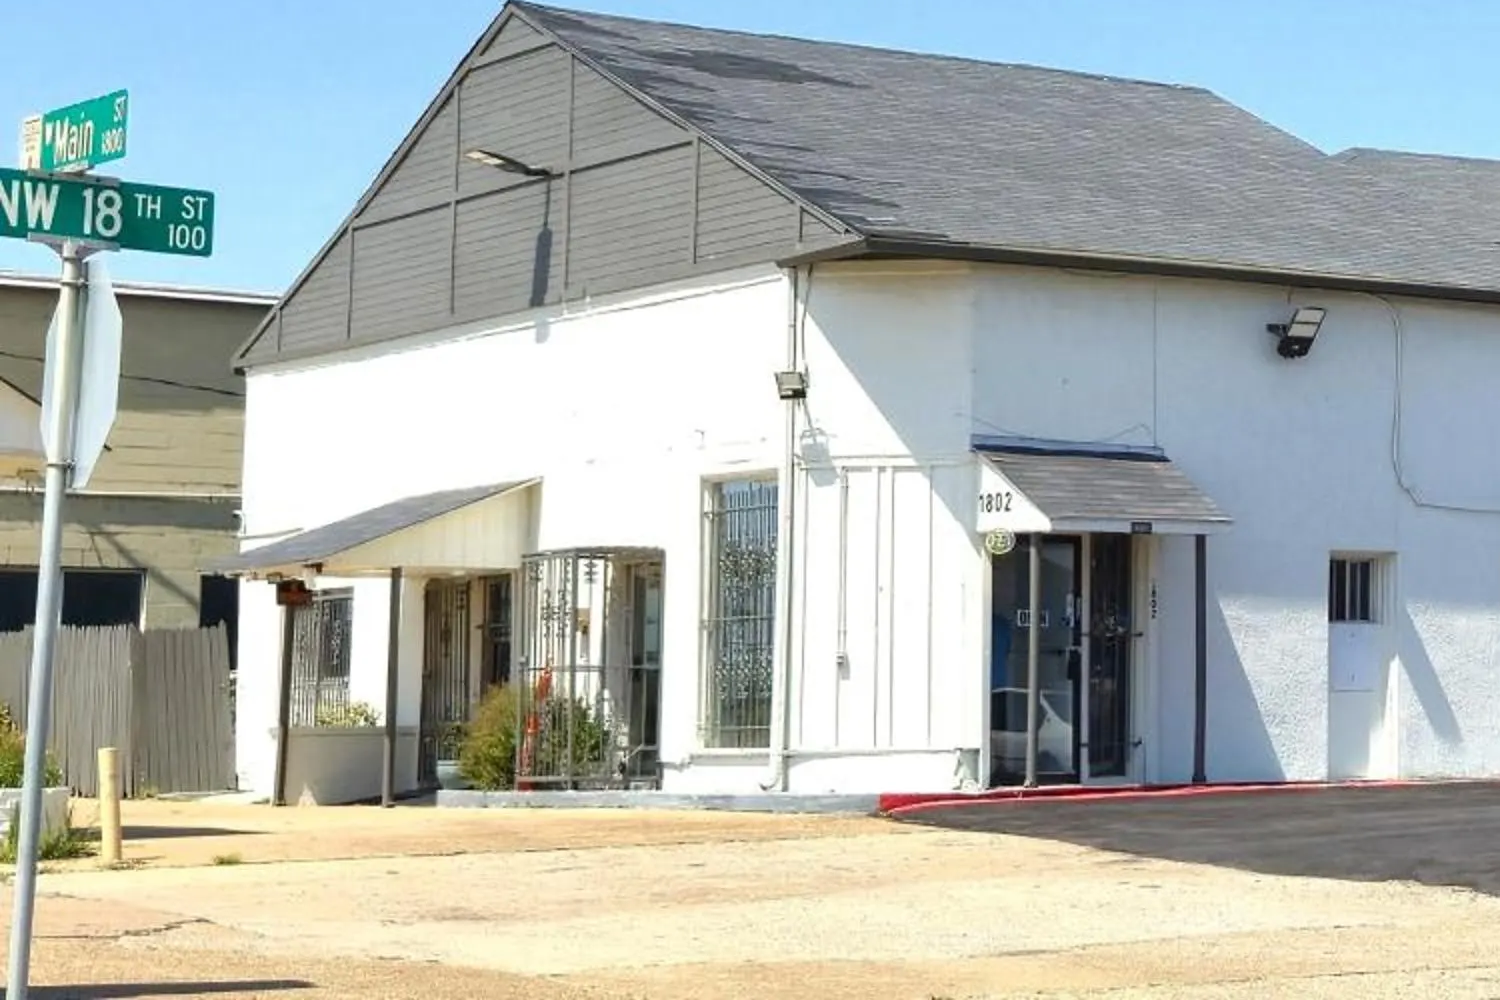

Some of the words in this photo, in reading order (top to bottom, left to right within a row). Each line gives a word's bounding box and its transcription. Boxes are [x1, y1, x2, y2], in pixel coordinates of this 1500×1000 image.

[54, 111, 94, 165] Main
[0, 179, 60, 230] NW
[82, 187, 123, 238] 18
[134, 193, 161, 220] TH
[181, 195, 208, 220] ST
[168, 223, 205, 250] 100
[979, 491, 1012, 513] 1802
